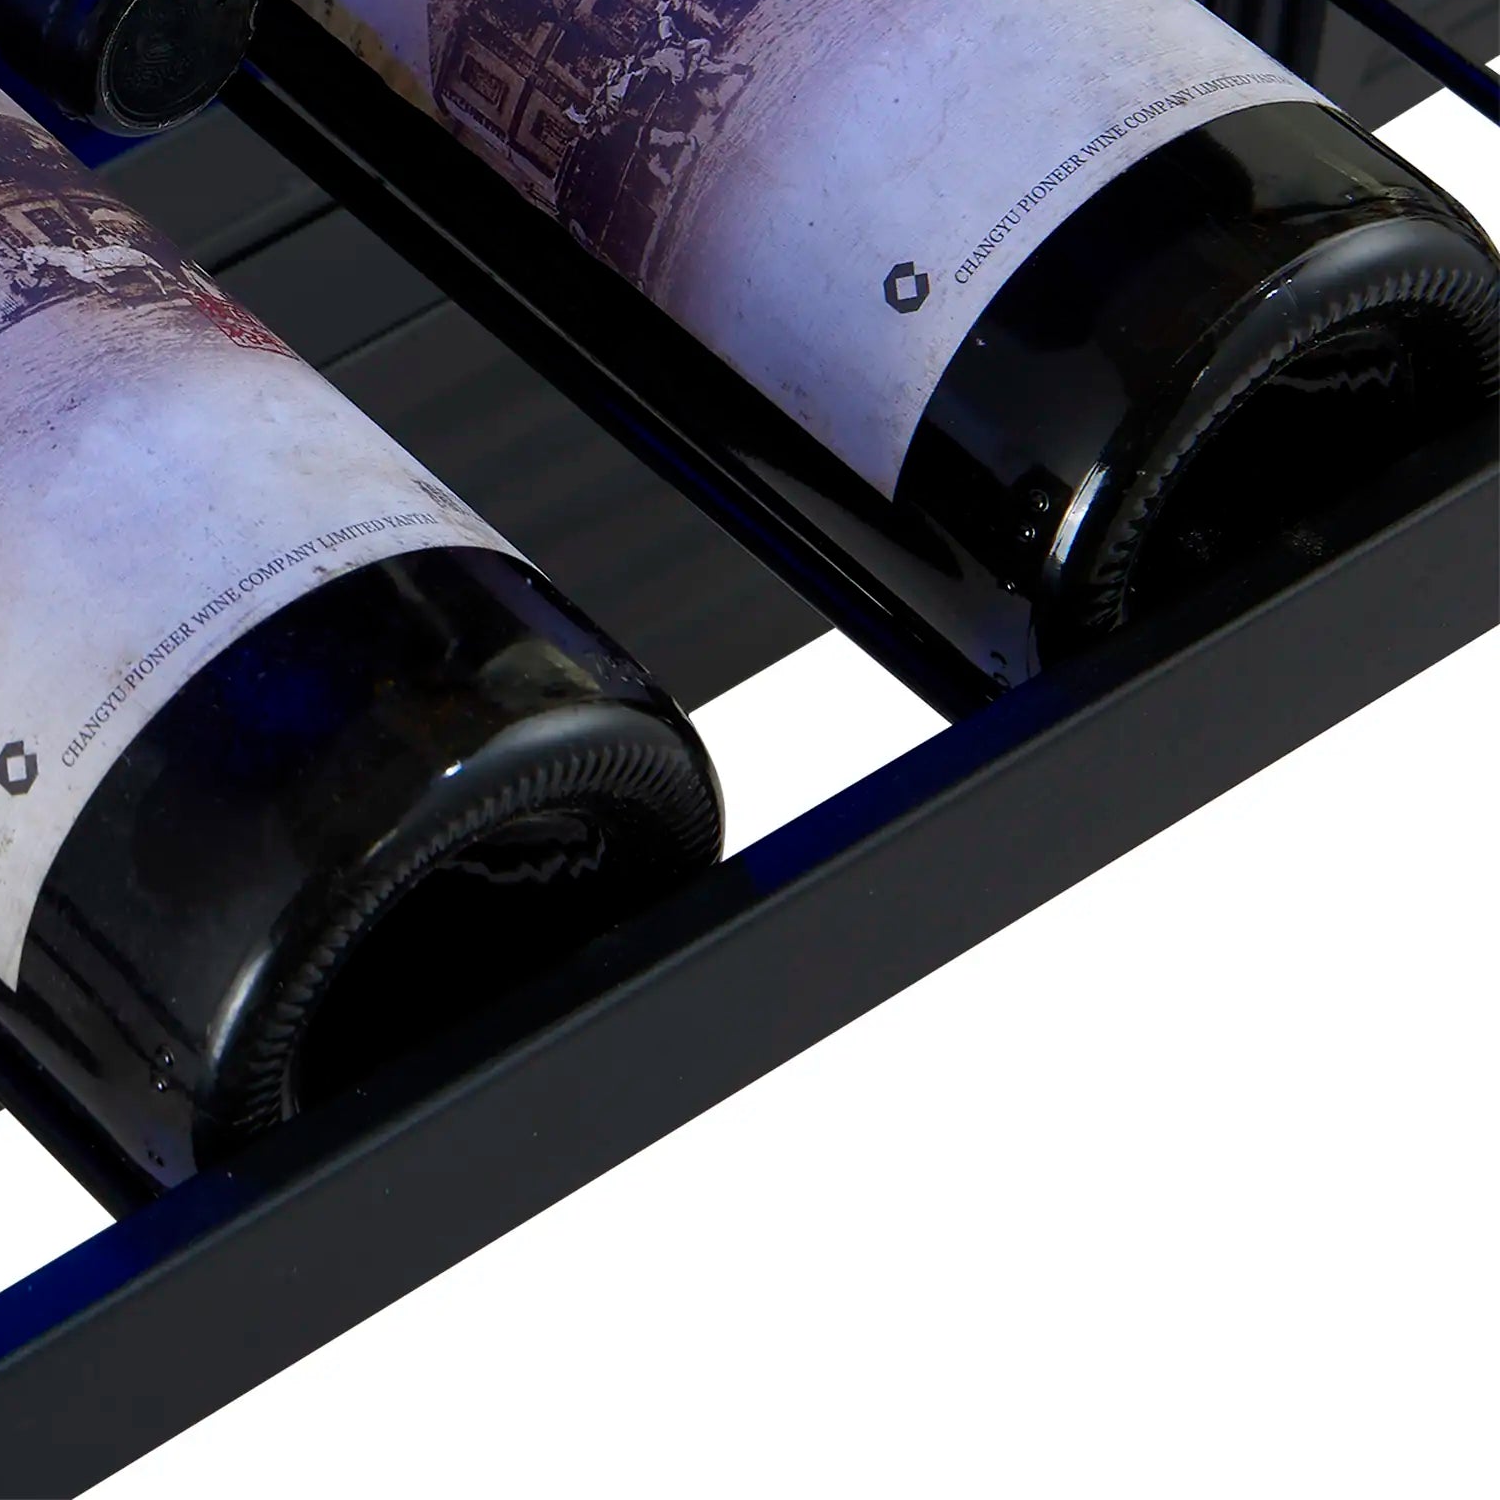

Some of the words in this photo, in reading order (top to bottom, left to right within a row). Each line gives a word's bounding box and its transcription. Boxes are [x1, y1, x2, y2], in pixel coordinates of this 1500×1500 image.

[954, 210, 1022, 284] CHANGYU
[1016, 154, 1088, 213] PIONEER
[1079, 124, 1128, 158] WINE
[1123, 88, 1195, 129] COMPANY
[1192, 74, 1252, 97] LIMITED
[62, 685, 128, 768] CHANGYU
[124, 622, 197, 690] PIONEER
[191, 588, 242, 626] WINE
[238, 541, 319, 593] COMPANY
[317, 519, 385, 549] LIMITED
